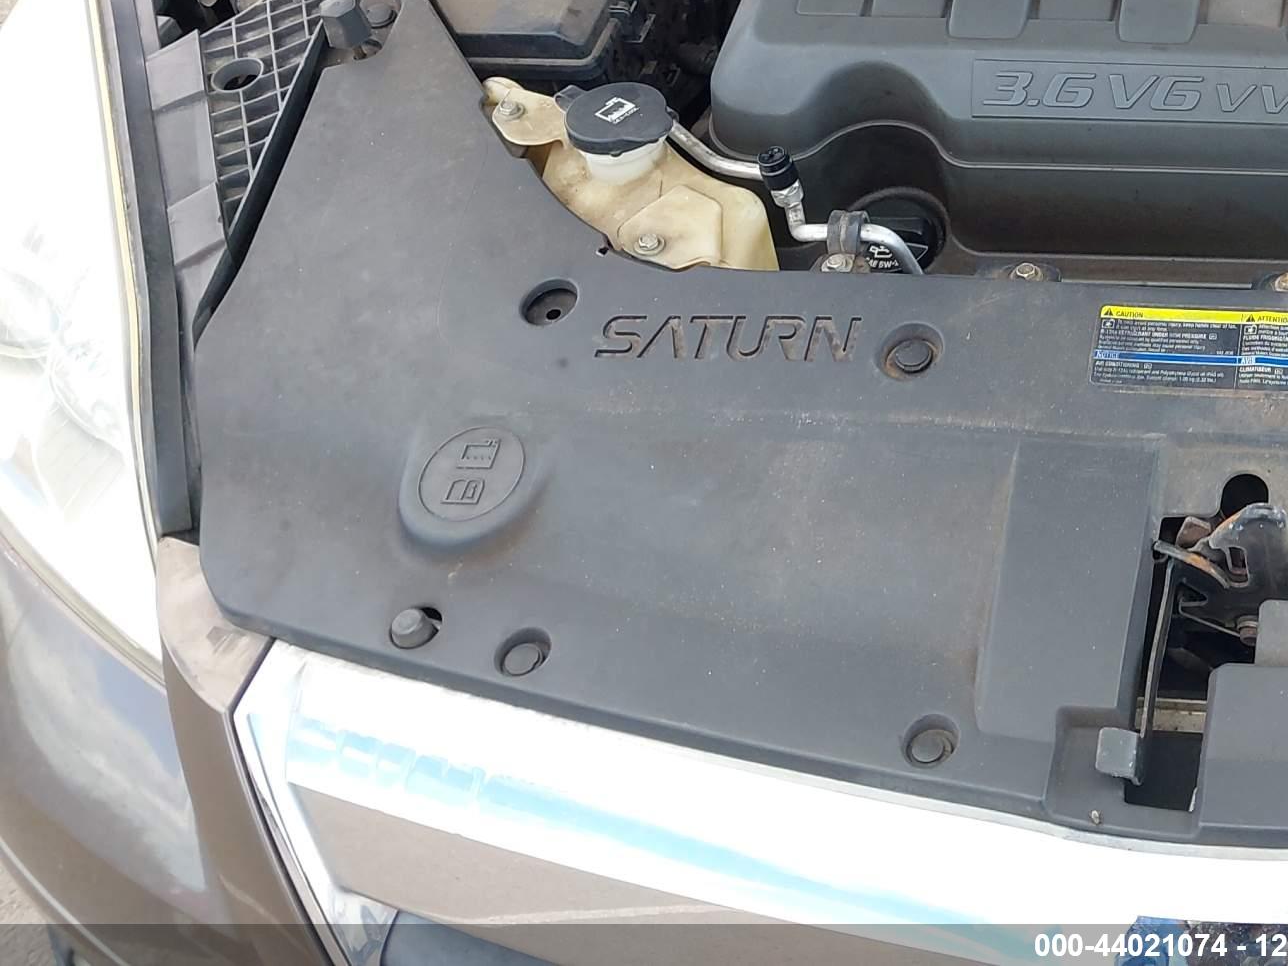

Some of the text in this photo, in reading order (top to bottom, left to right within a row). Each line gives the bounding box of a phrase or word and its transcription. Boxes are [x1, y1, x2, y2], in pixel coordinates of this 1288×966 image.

[983, 71, 1096, 108] 3.6
[1108, 74, 1204, 111] V6
[594, 315, 862, 362] SATURN
[1096, 351, 1119, 359] NOTICE
